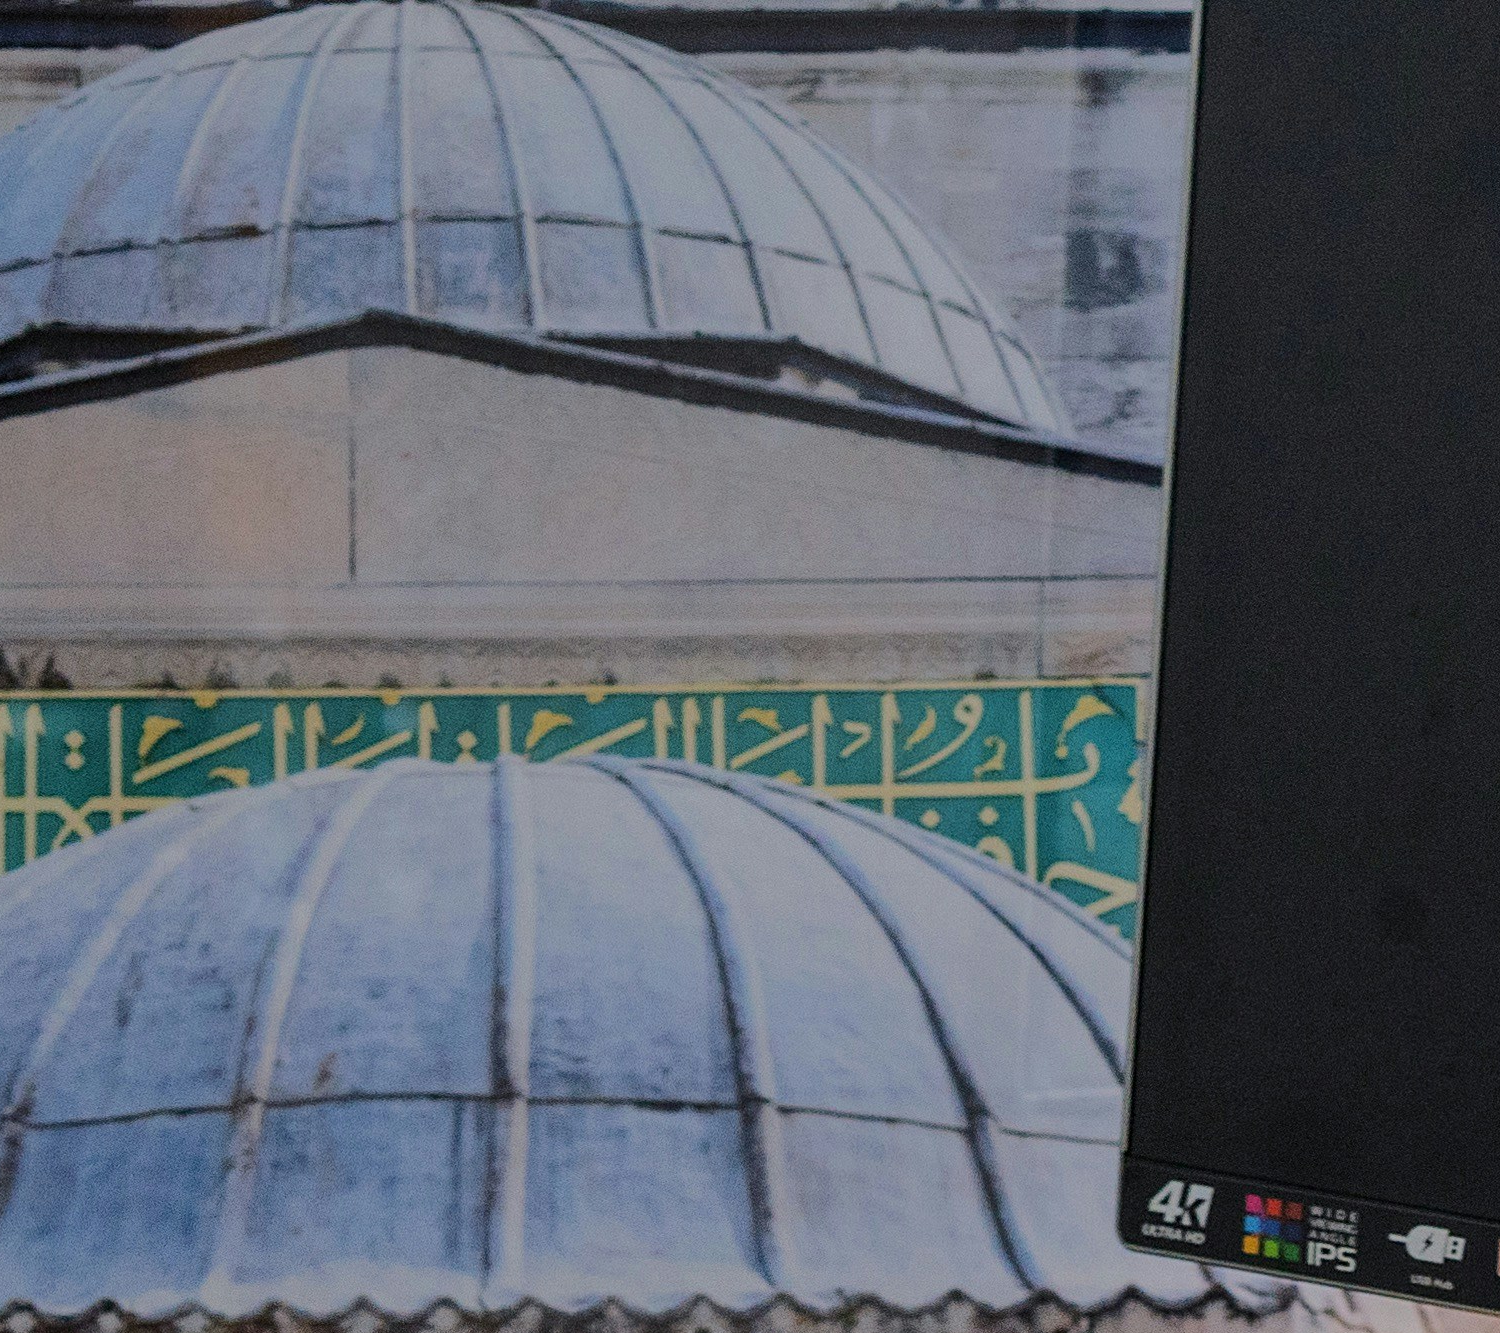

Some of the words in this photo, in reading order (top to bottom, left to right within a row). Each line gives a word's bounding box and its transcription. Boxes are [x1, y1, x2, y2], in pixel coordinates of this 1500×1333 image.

[1148, 1179, 1216, 1229] 4K
[1183, 1231, 1206, 1245] HD
[1306, 1240, 1359, 1274] IPS
